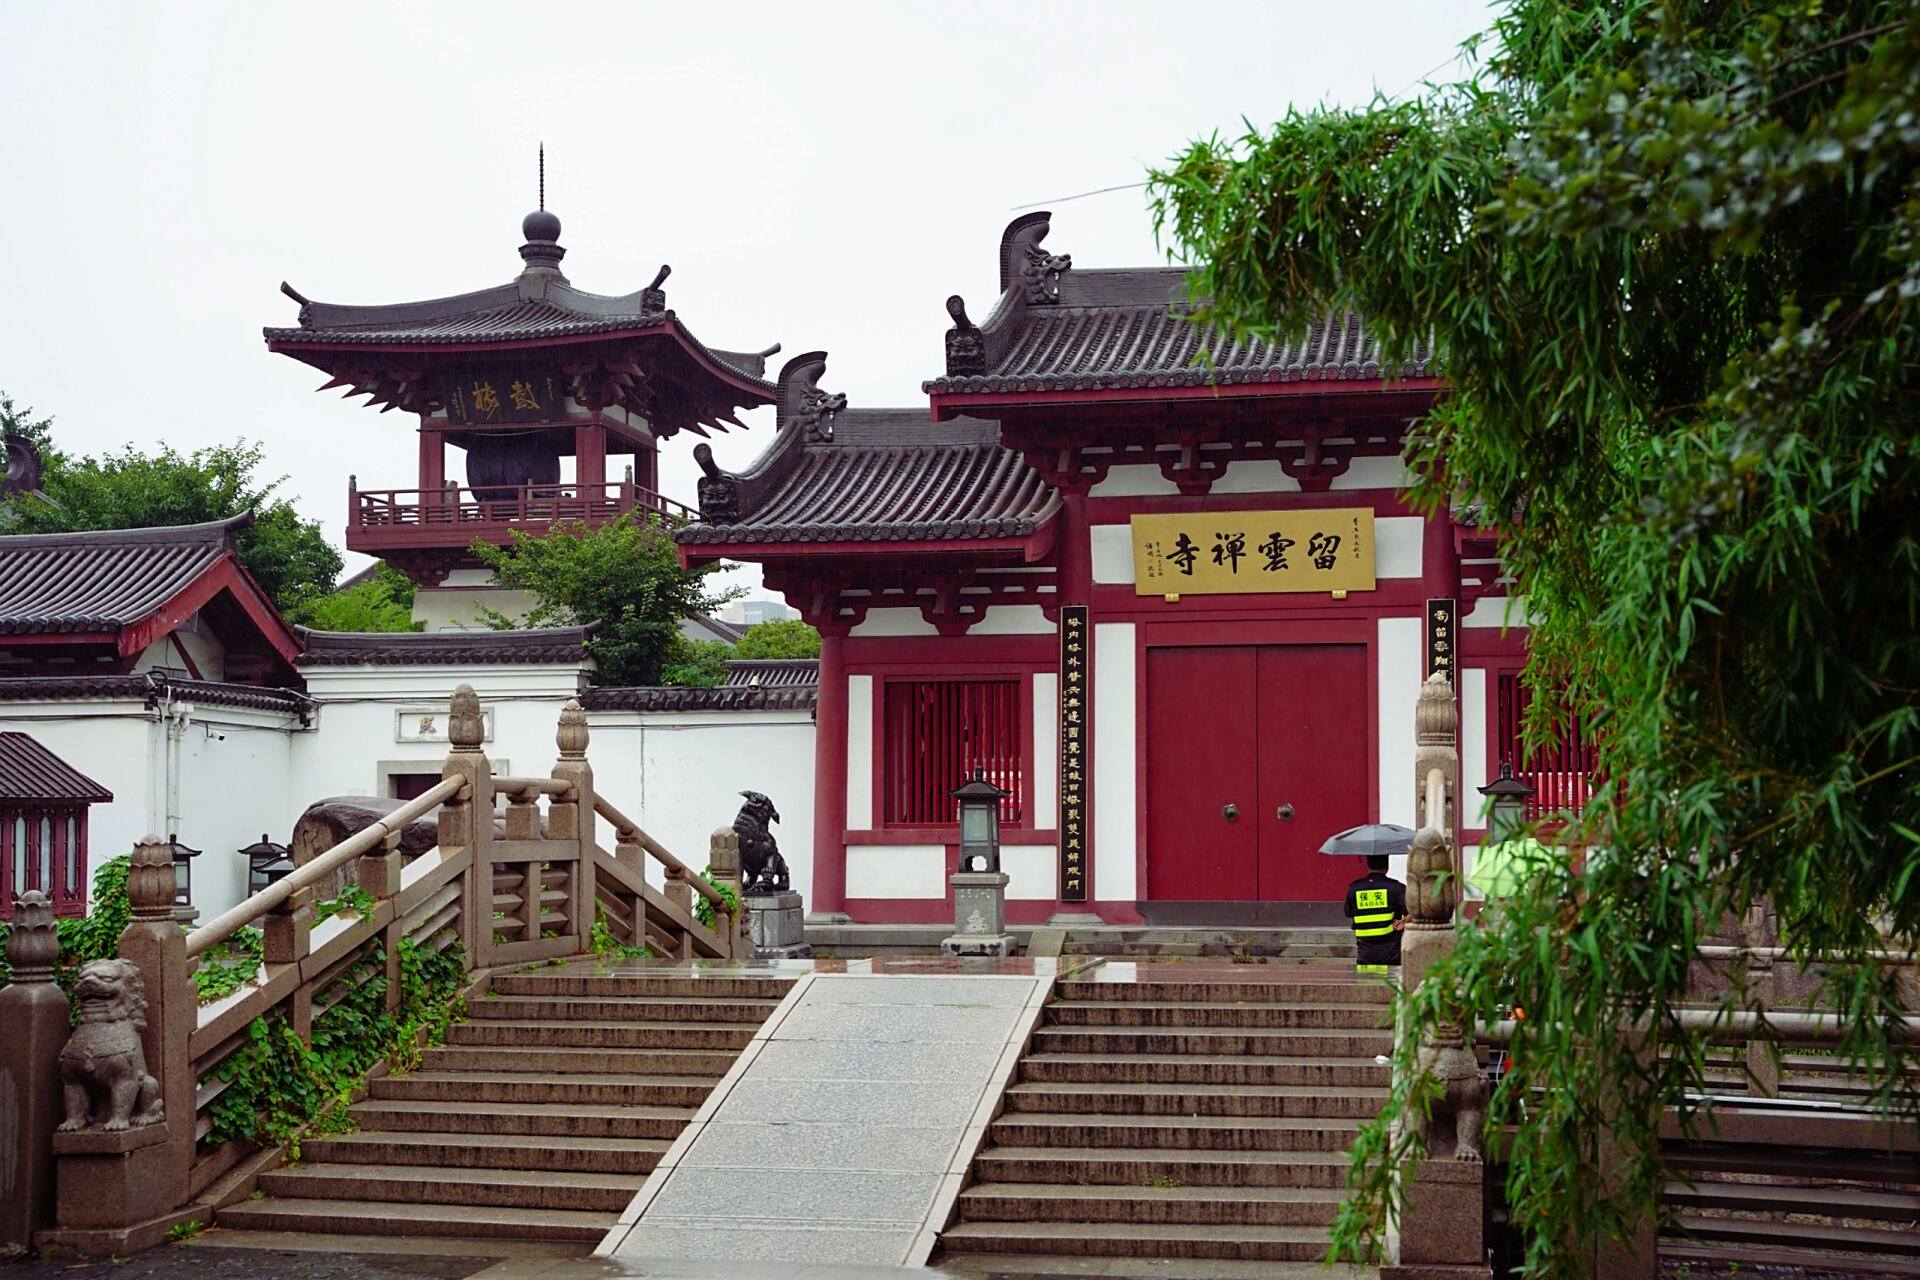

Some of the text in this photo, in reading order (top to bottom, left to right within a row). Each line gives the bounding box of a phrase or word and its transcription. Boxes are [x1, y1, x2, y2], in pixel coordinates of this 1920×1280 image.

[1166, 532, 1342, 576] 留雲禪寺
[1360, 892, 1382, 901] 保安
